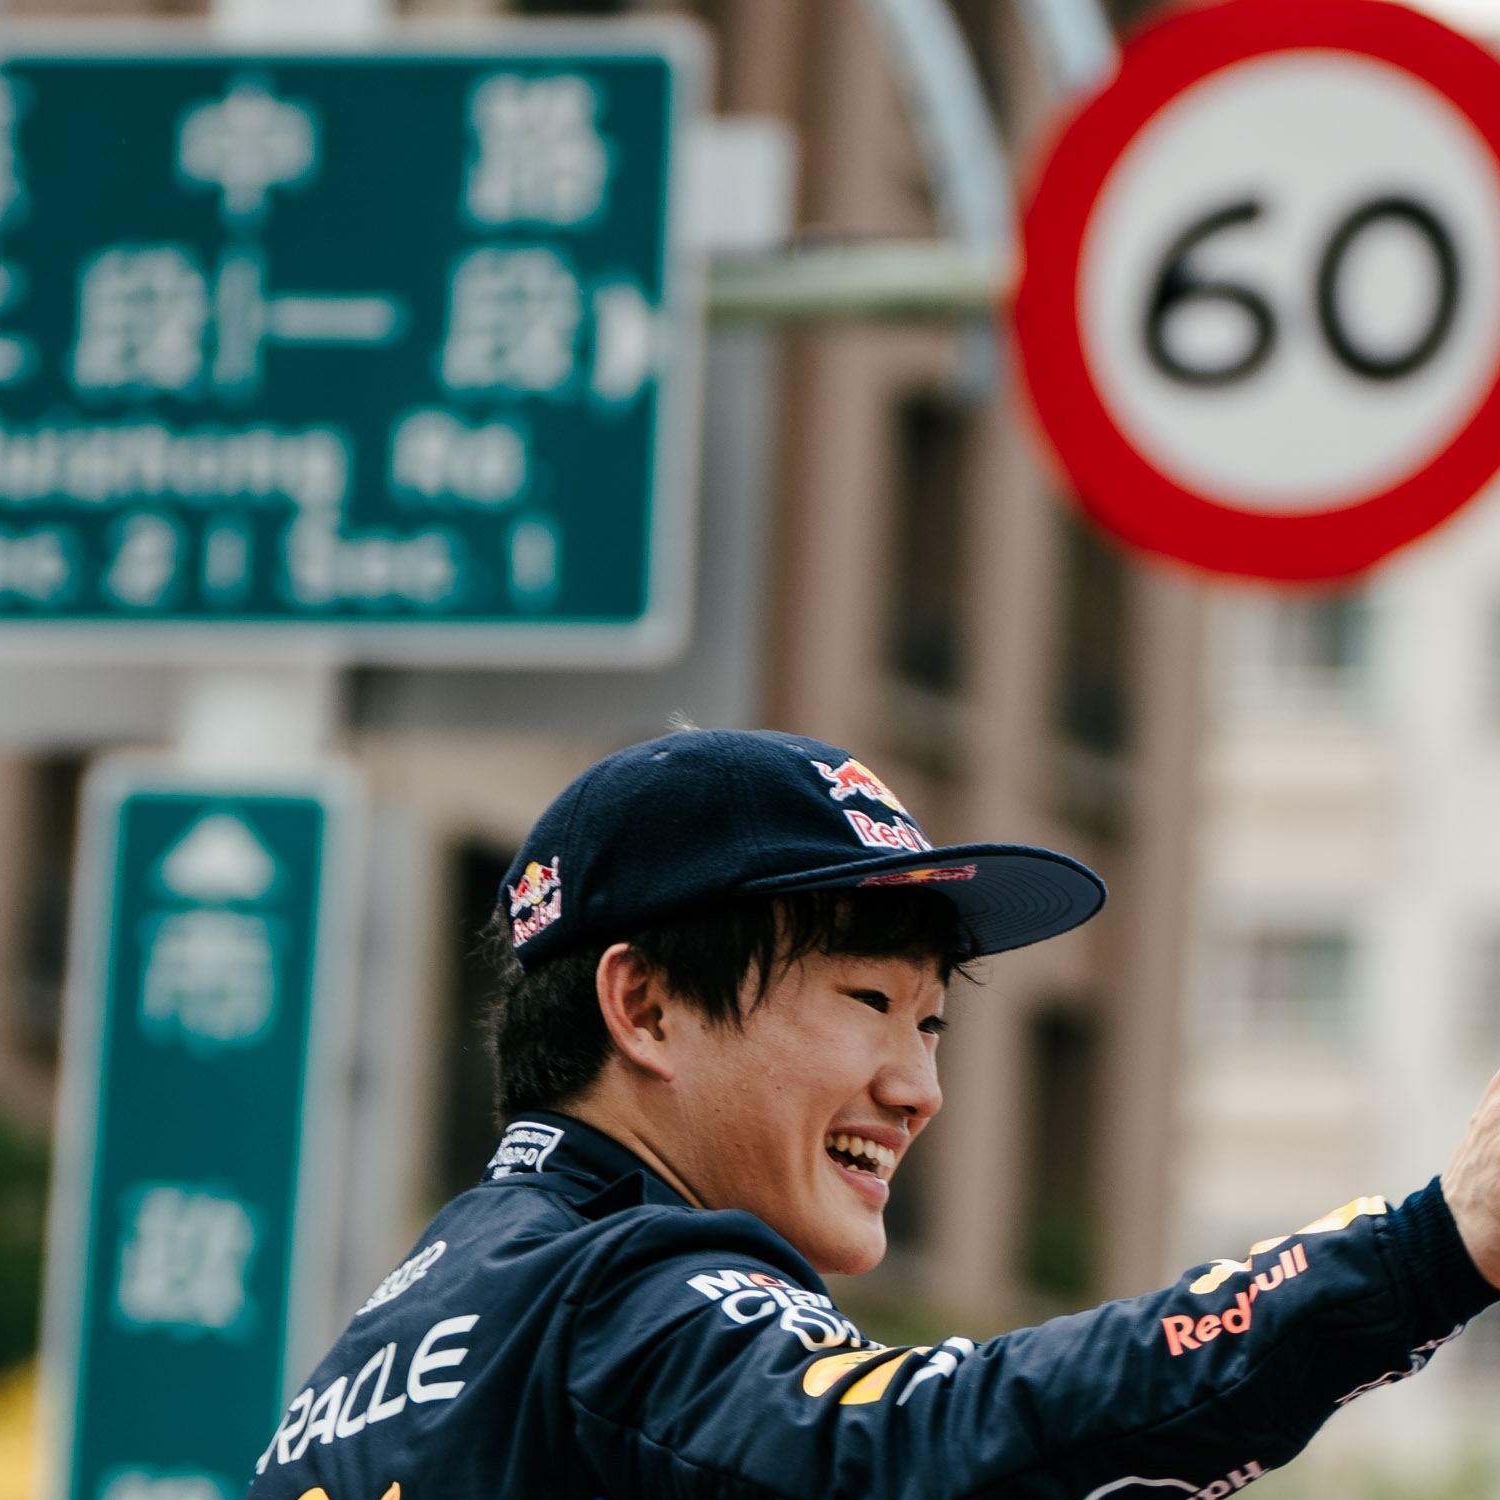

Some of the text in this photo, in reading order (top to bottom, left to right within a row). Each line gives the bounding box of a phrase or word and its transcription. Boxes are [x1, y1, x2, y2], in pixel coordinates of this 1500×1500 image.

[1142, 197, 1460, 386] 60
[255, 1314, 480, 1475] RACLE
[1161, 1291, 1252, 1357] Red
